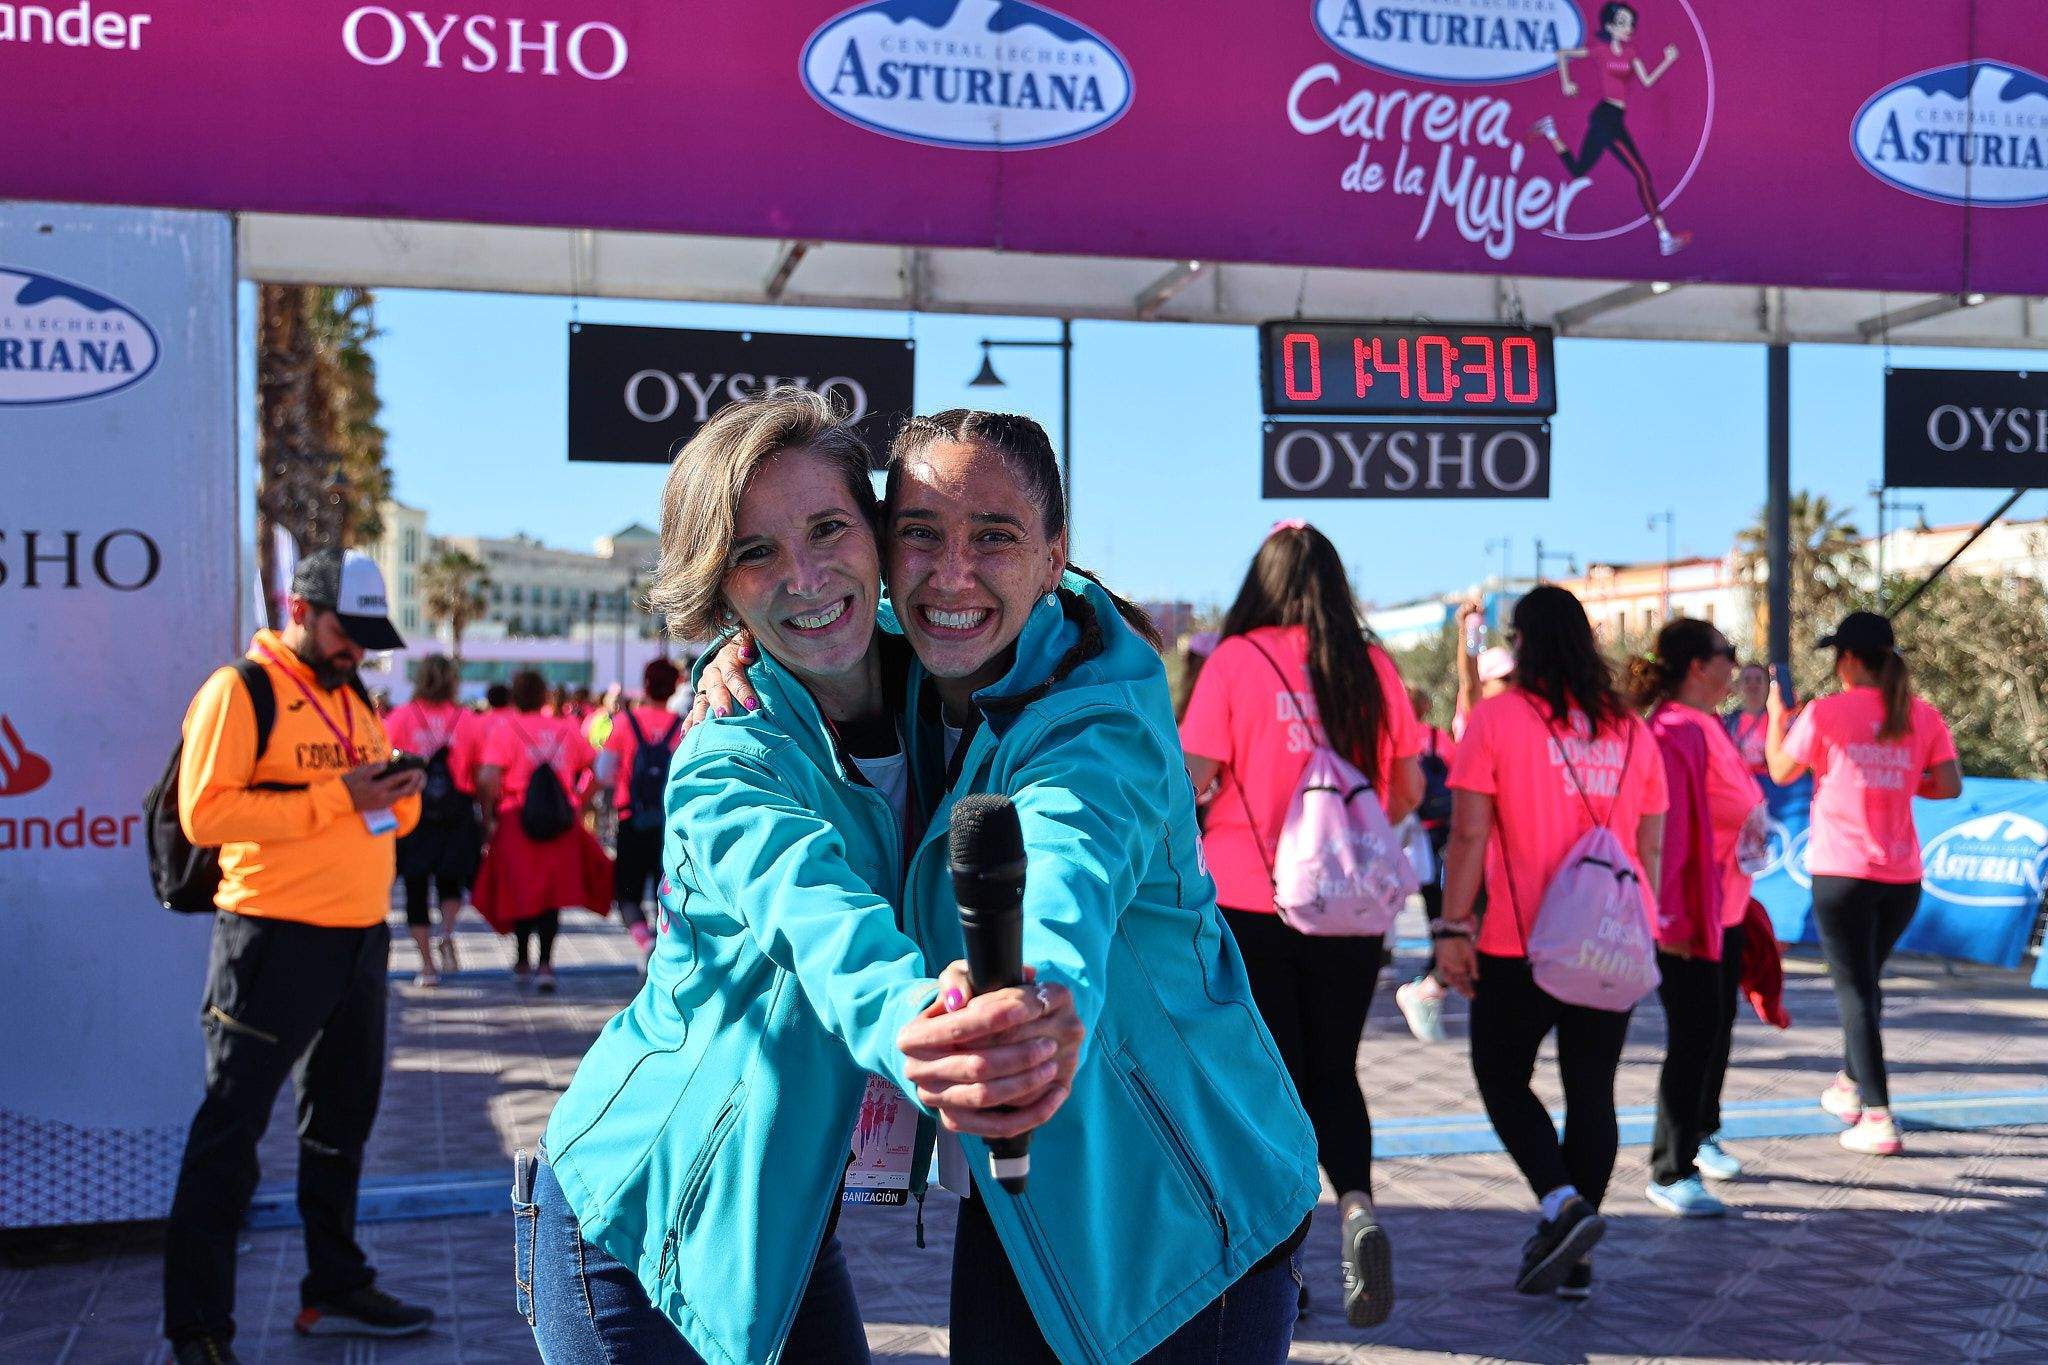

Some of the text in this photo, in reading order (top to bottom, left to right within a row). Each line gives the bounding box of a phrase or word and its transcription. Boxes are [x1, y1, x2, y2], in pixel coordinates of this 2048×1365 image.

[341, 5, 629, 80] OYSHO
[880, 36, 985, 59] CENTRAL
[1336, 0, 1561, 51] ASTURIANA
[828, 35, 1106, 113] ASTURIANA
[1287, 62, 1513, 147] Carrera
[1340, 142, 1594, 261] de la Mujer
[0, 338, 135, 374] RIANA
[623, 369, 869, 429] OYSO
[1274, 429, 1541, 492] OYSHO
